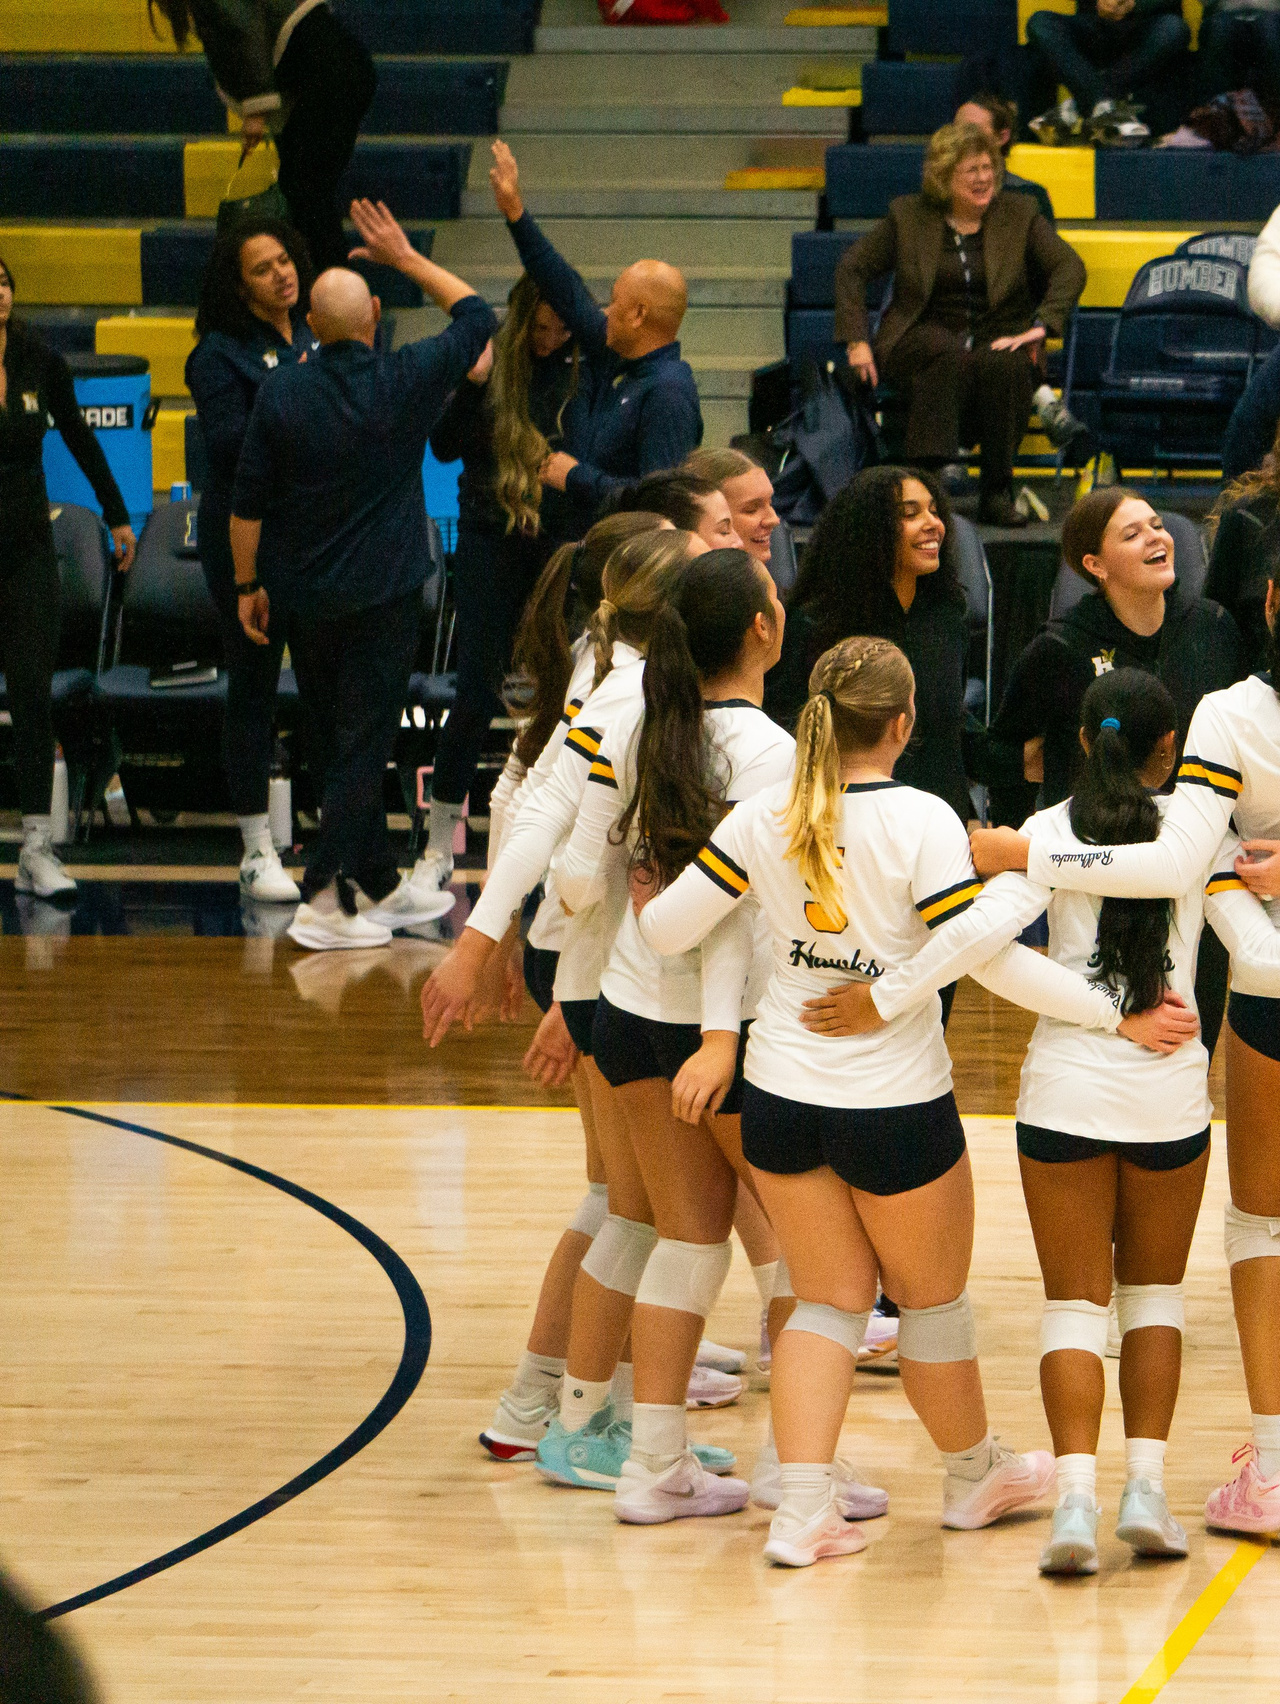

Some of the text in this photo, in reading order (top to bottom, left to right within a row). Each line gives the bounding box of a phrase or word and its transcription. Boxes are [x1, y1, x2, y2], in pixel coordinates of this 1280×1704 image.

[1147, 260, 1236, 300] HUMBER
[1049, 850, 1114, 868] Rollhawks
[787, 939, 885, 978] Hawks
